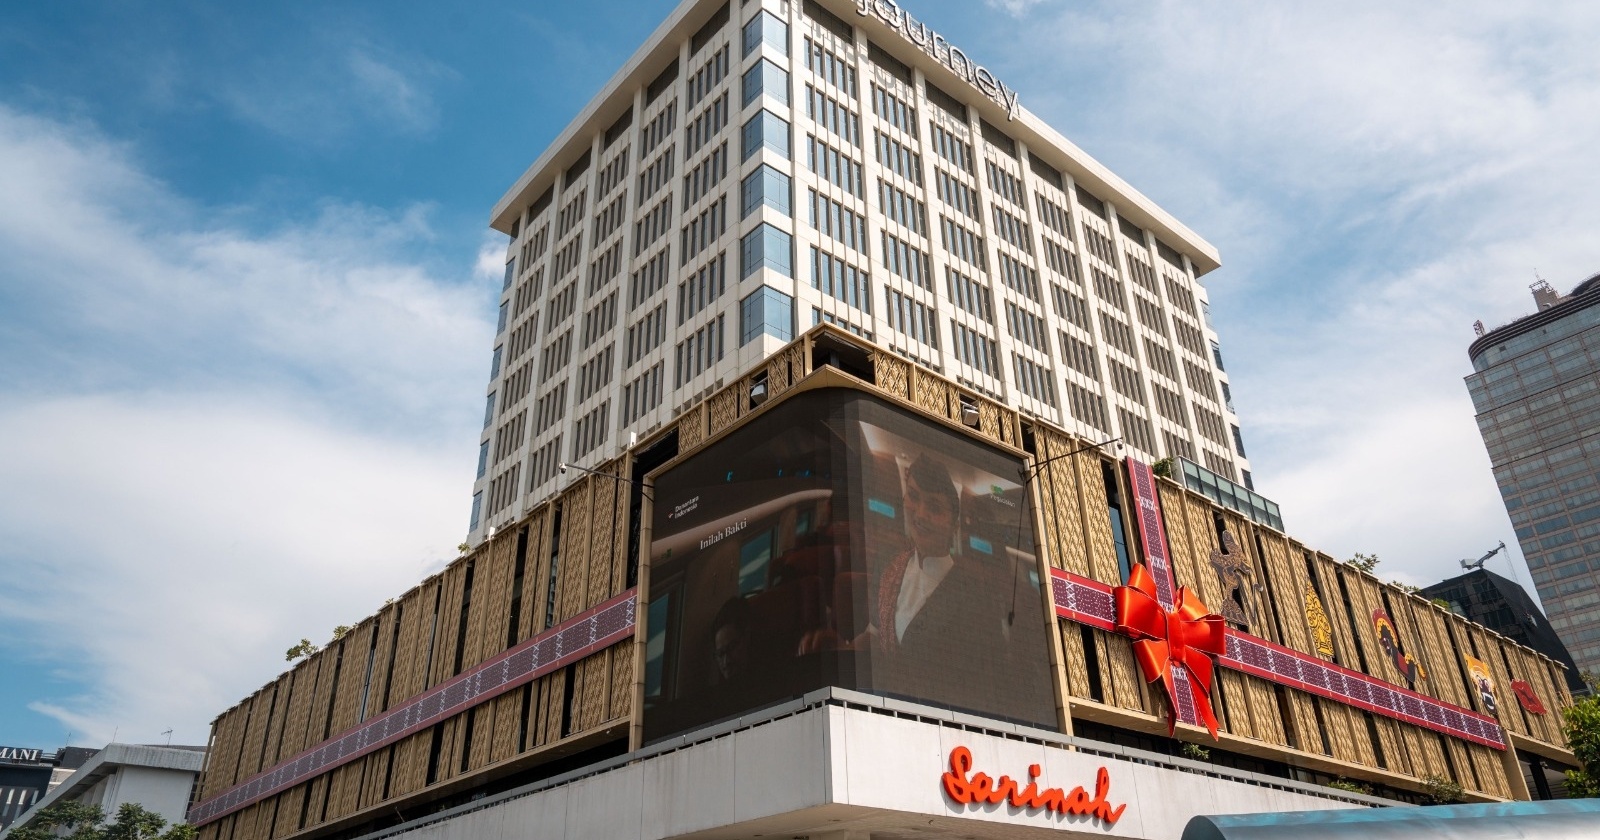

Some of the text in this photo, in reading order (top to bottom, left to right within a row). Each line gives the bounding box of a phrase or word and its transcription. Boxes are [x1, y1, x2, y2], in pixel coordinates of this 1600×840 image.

[674, 502, 698, 519] Indonesia
[700, 518, 747, 550] Inilah Bakti
[942, 746, 1127, 823] Sarinah
